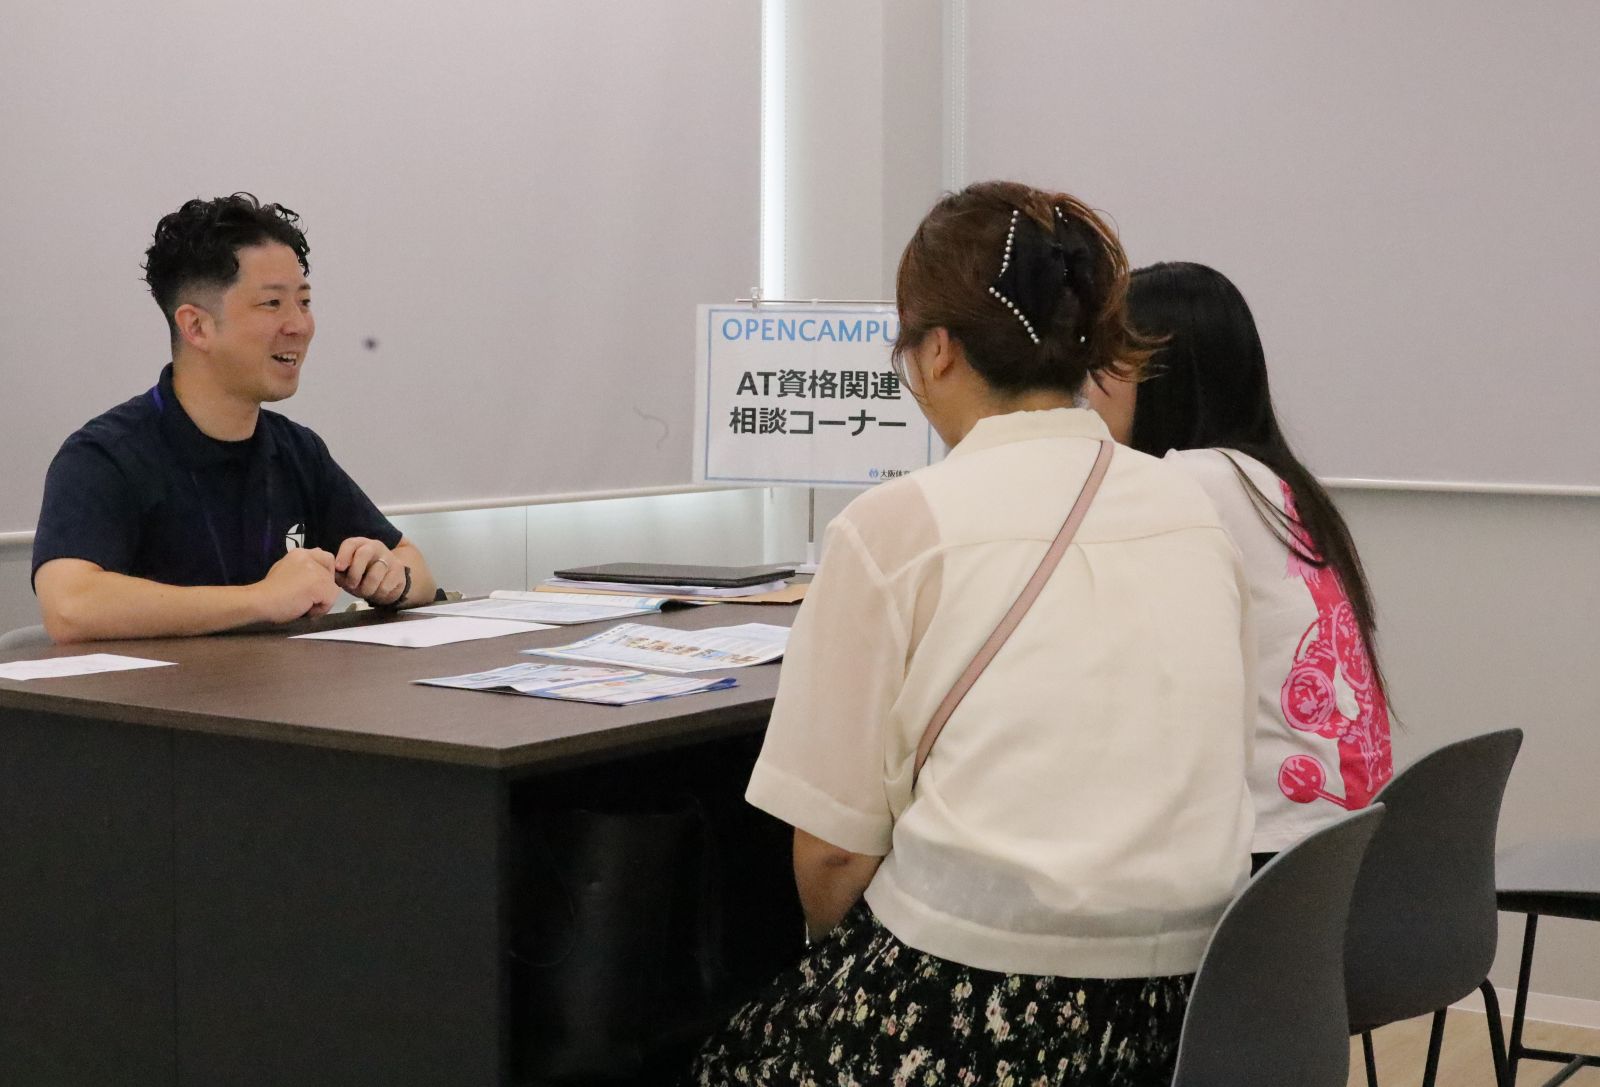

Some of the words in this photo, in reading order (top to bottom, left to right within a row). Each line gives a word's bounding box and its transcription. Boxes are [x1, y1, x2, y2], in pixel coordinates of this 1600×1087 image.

[722, 318, 900, 342] OPENCAMPU
[736, 369, 901, 399] AT資格関連
[729, 406, 906, 436] 相談コーナー
